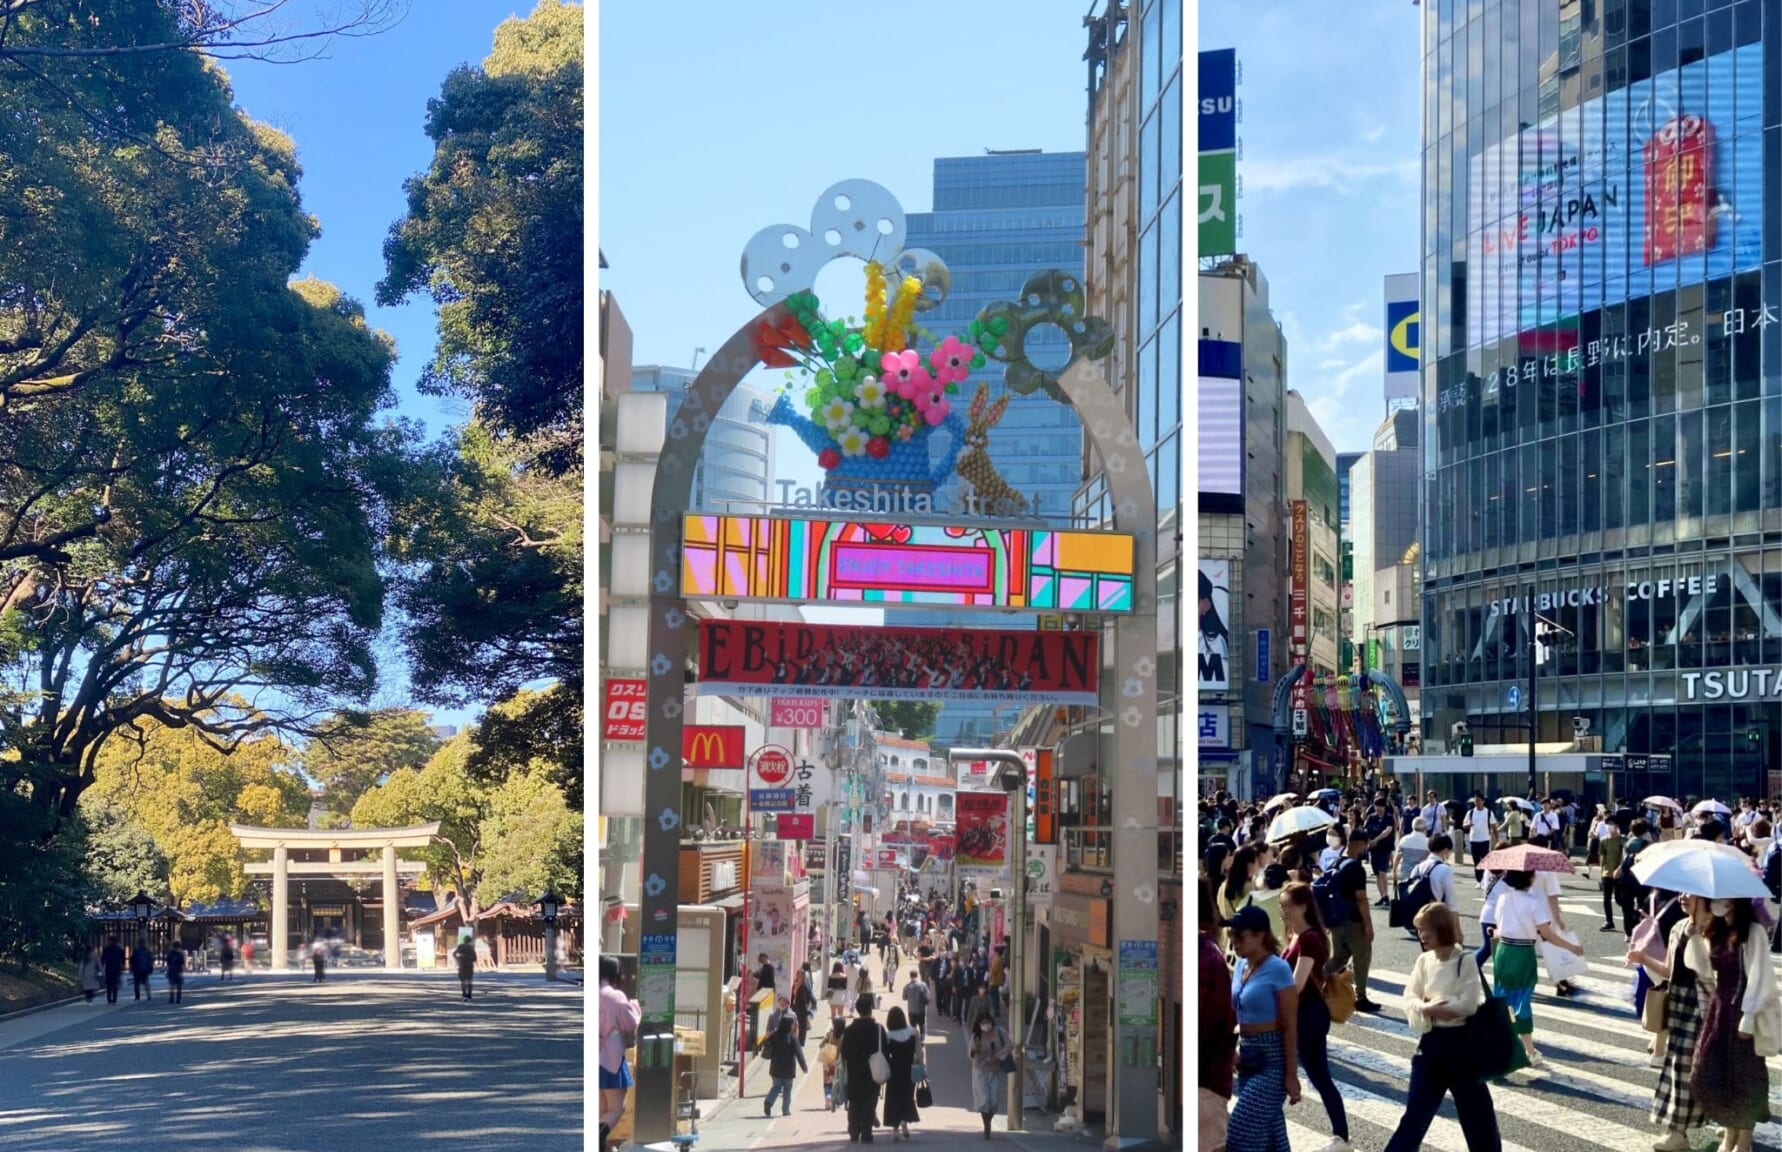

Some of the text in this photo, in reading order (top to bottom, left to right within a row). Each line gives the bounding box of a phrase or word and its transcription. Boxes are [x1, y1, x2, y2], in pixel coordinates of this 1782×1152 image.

[1198, 95, 1232, 114] SU
[1484, 184, 1618, 254] LVE JAPAN
[1723, 301, 1780, 338] 日本
[776, 479, 932, 515] Takeshita
[1624, 575, 1718, 601] COFFEE
[607, 700, 646, 721] OS
[775, 708, 818, 726] ¥300
[759, 759, 787, 774] 消火栓
[795, 759, 816, 808] 古着
